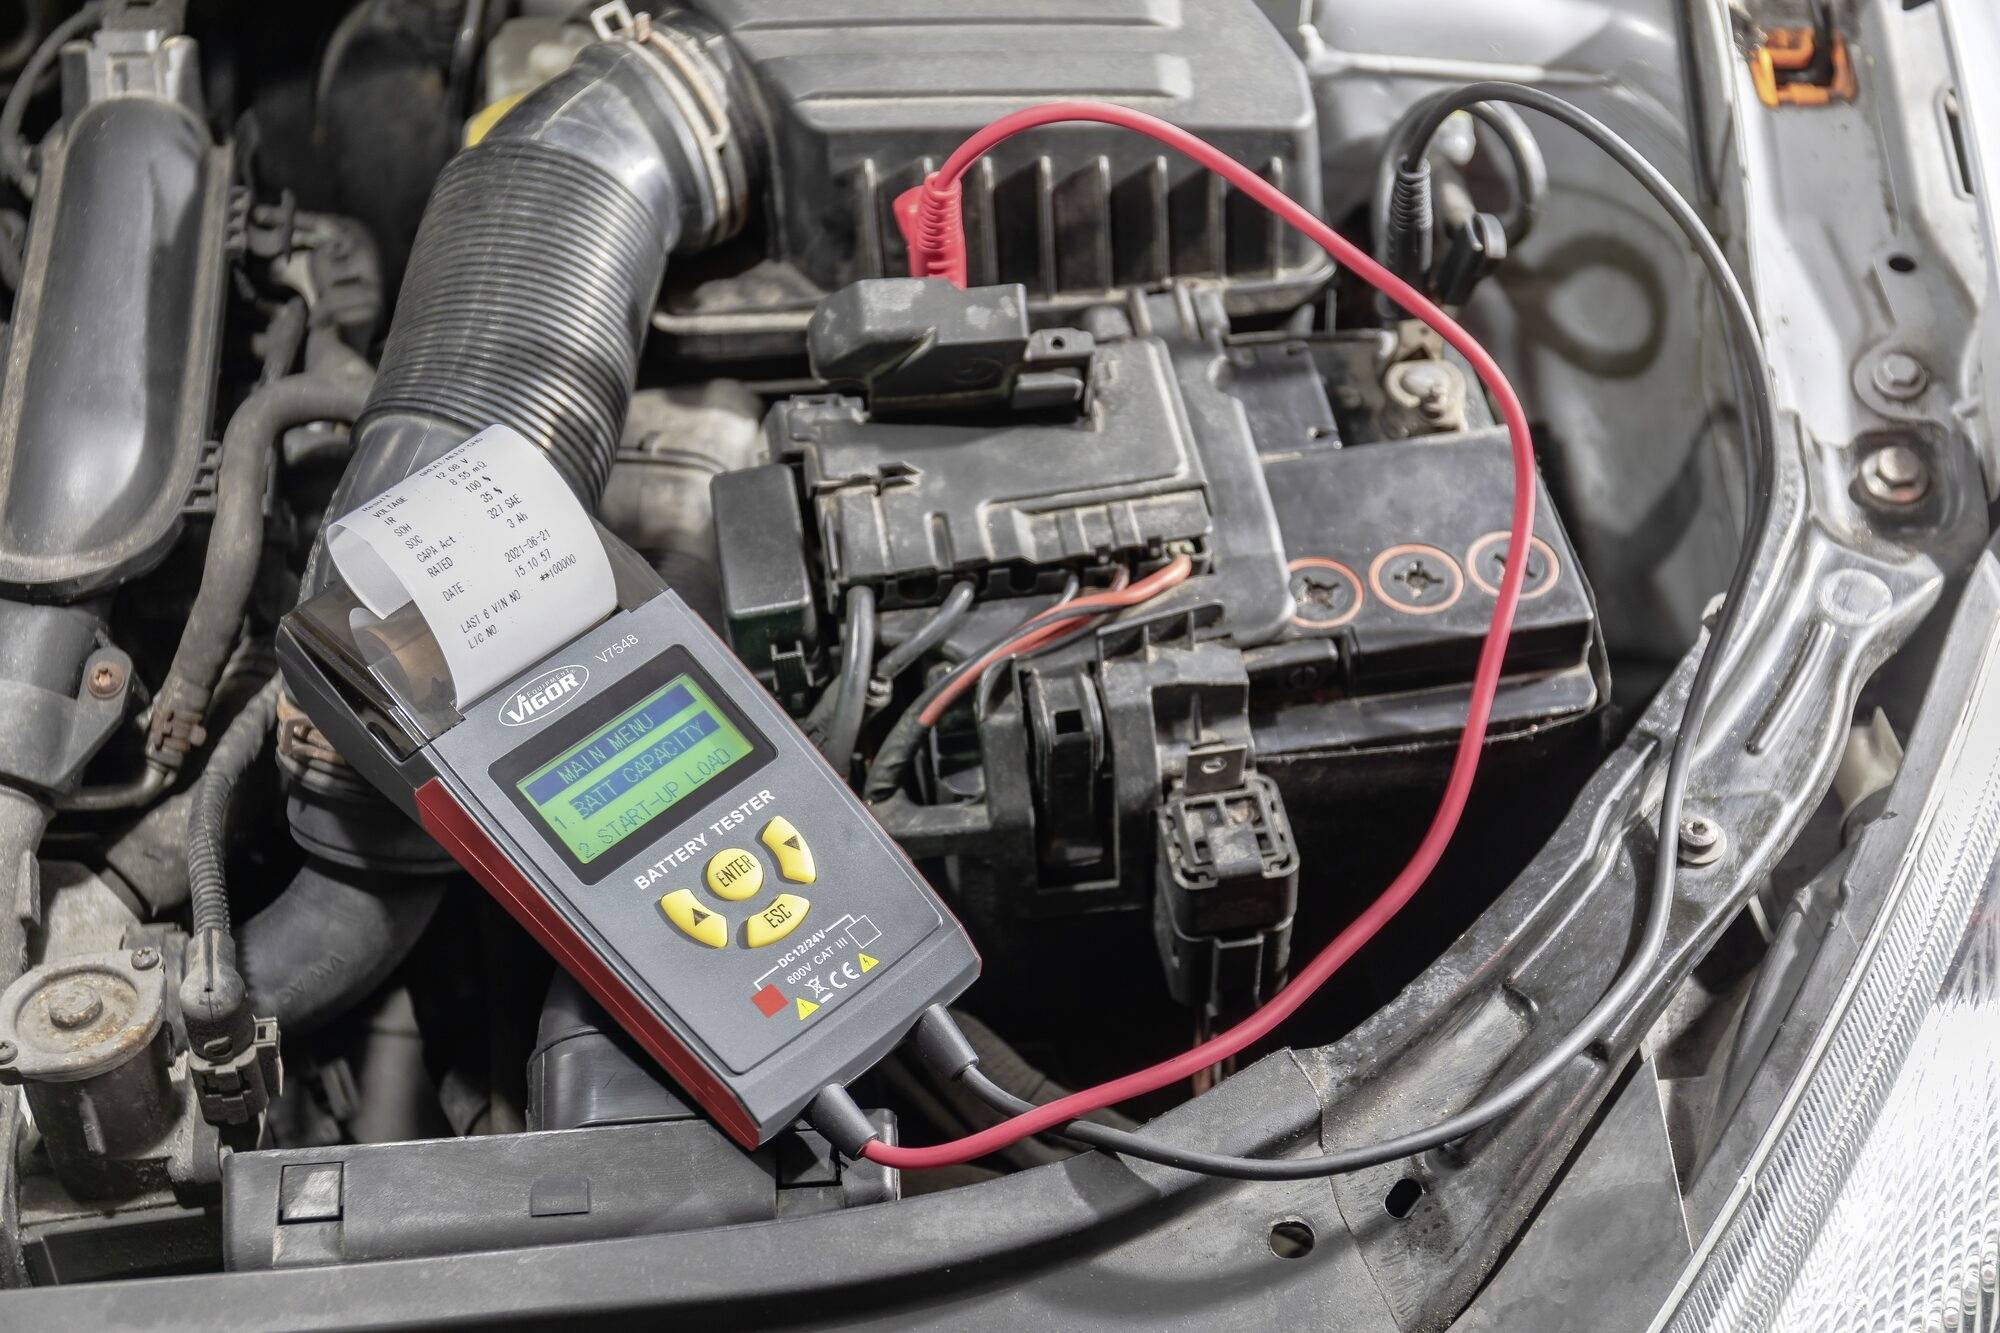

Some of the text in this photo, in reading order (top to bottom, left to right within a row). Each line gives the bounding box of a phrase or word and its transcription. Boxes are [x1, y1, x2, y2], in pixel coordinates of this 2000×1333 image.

[372, 497, 408, 518] VOLTAGE
[384, 516, 397, 526] IR
[394, 523, 412, 537] SOH
[465, 479, 482, 493] 100
[405, 534, 423, 550] SOC
[480, 491, 494, 503] 35
[417, 493, 523, 563] CAPA Act 327 SAE
[427, 511, 529, 578] RATED 3 Ah
[442, 528, 551, 602] DATE 2021-06-21
[461, 614, 480, 634] LAST
[483, 608, 490, 619] 6
[491, 597, 509, 614] VIN
[468, 632, 485, 649] LIC
[594, 634, 639, 663] V7548
[557, 712, 655, 785] MAIN MENU
[622, 719, 706, 783] CAPACITY
[684, 747, 731, 785] LOAD
[634, 789, 776, 890] BATTERY TESTER
[716, 854, 756, 888] ENTER
[763, 903, 792, 929] ESC
[777, 929, 826, 968] DC12/24V
[787, 937, 848, 985] 600V CAT III
